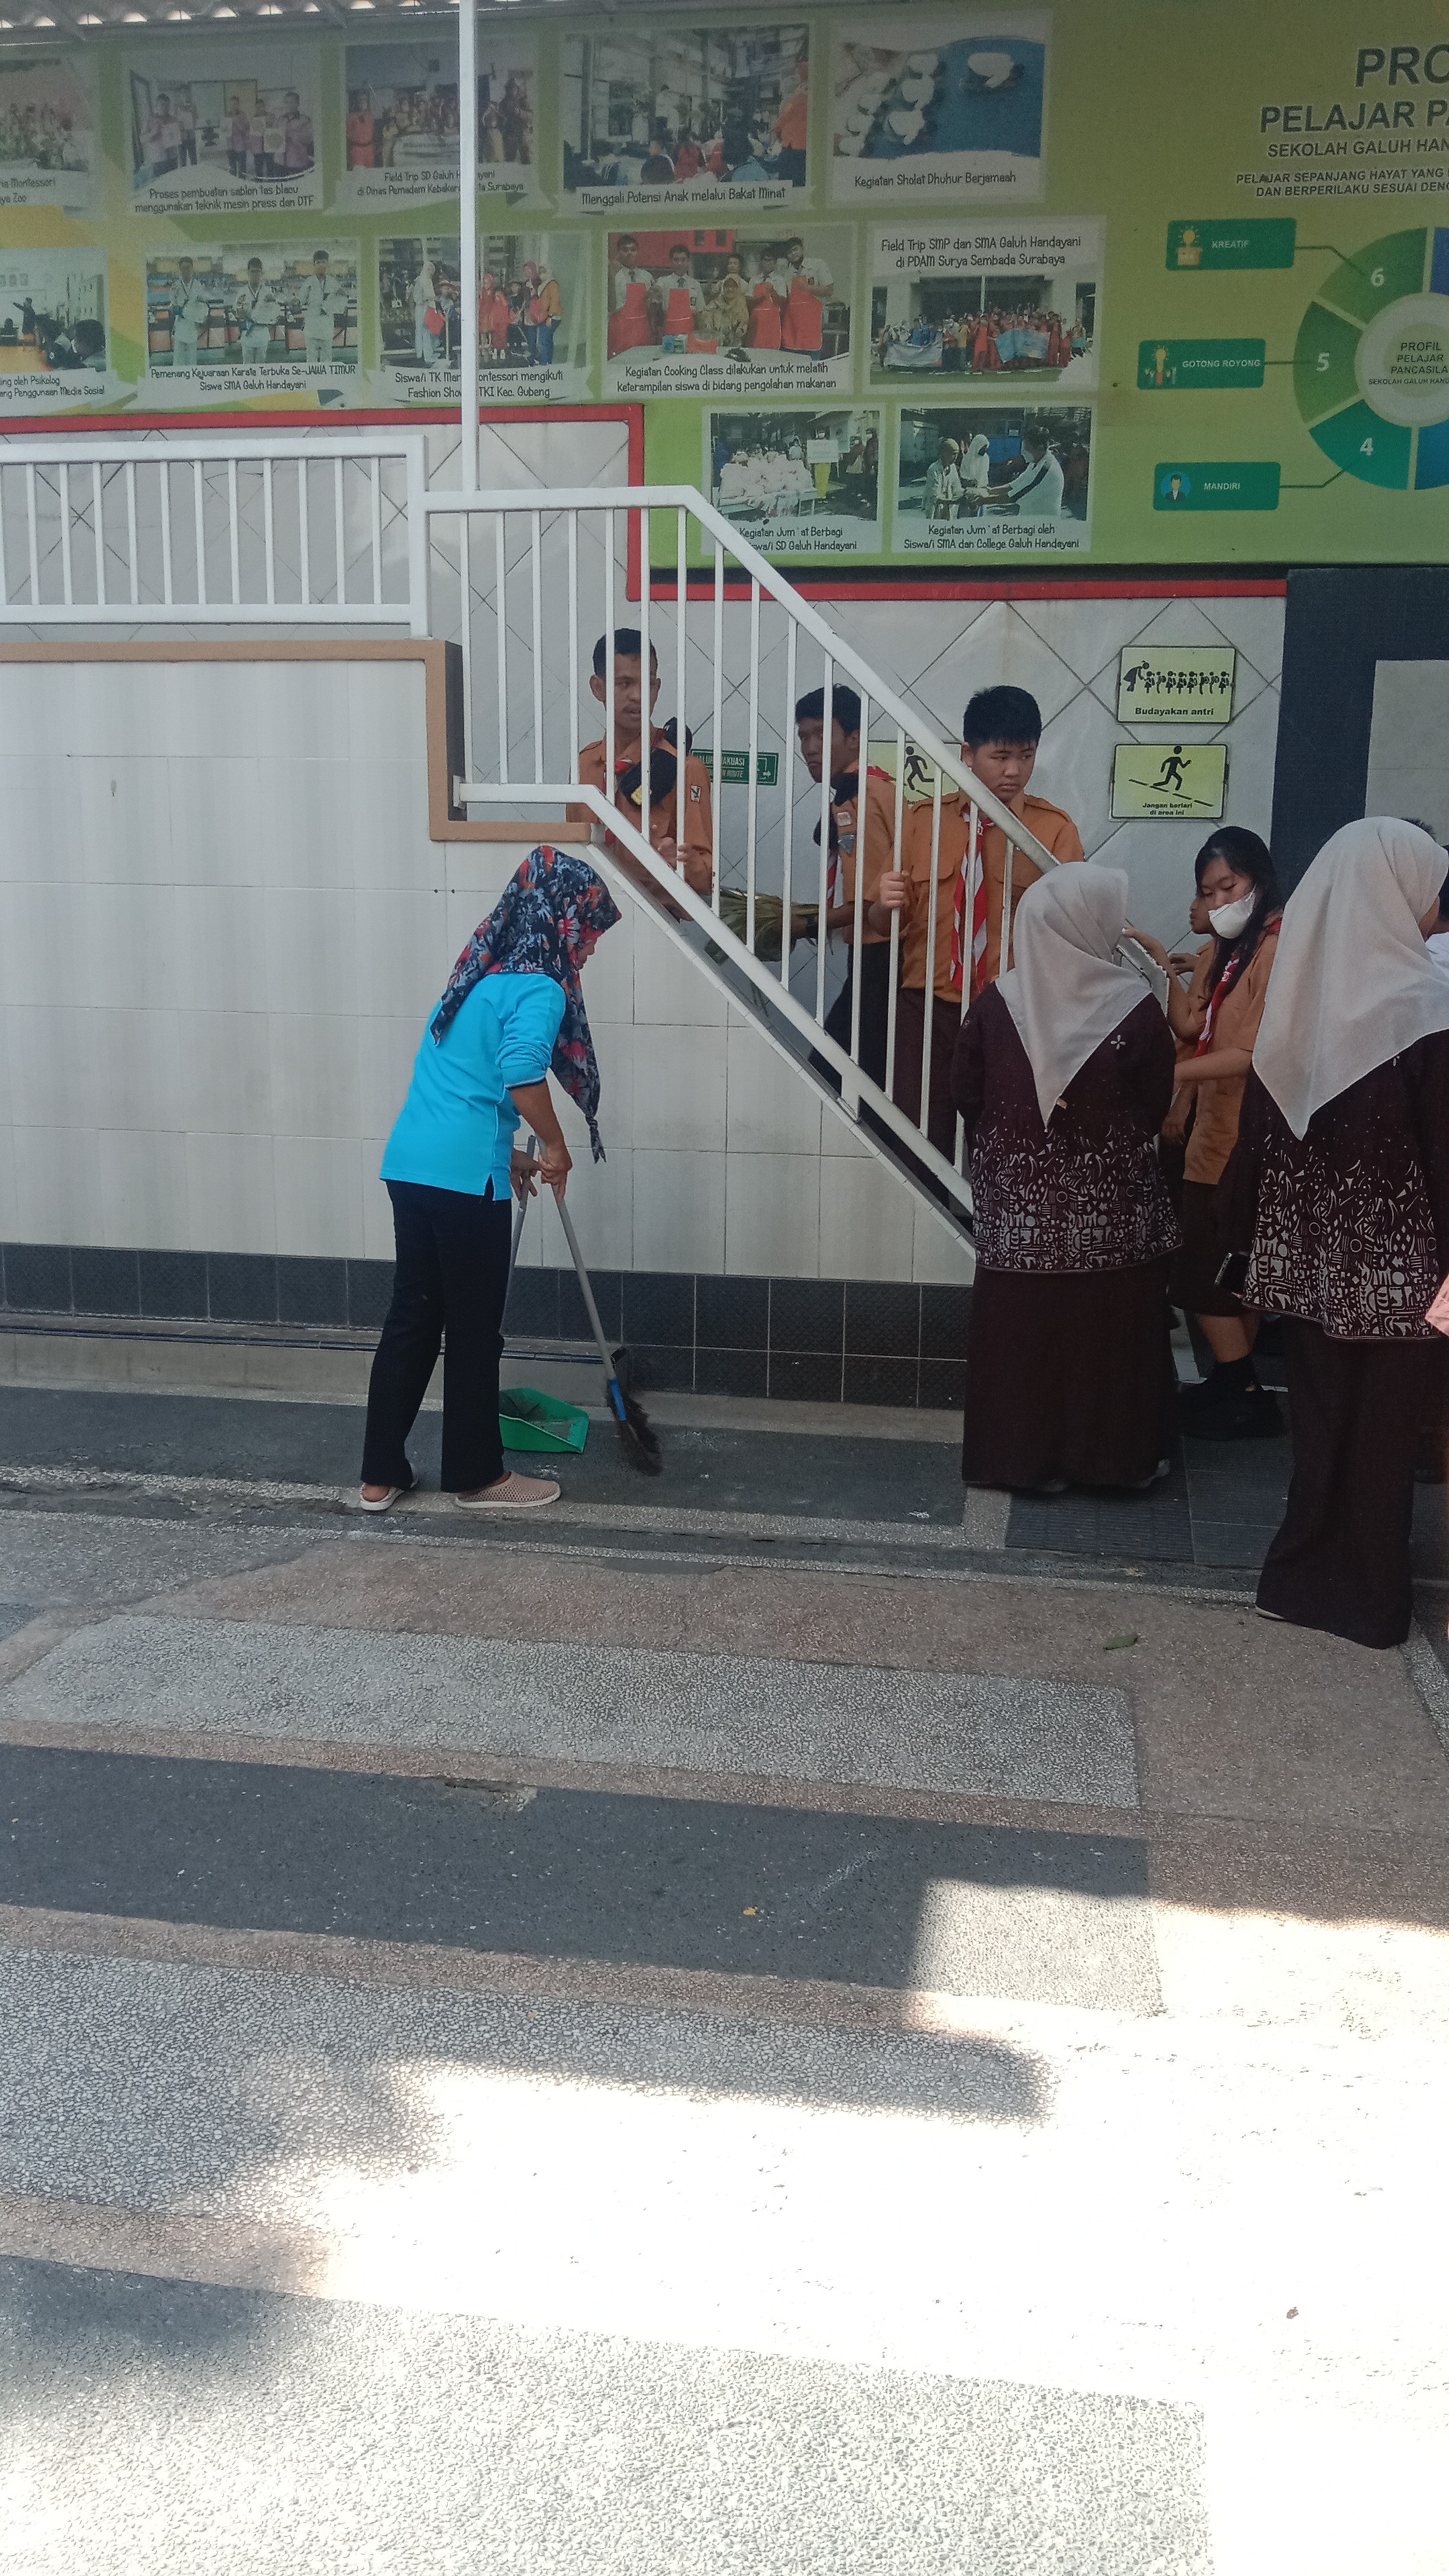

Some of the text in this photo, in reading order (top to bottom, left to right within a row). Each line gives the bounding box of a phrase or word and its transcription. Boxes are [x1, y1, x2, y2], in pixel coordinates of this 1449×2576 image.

[1260, 101, 1415, 133] PELAJAR
[1267, 142, 1348, 158] SEKOLAH
[1353, 140, 1410, 155] GALUH
[10, 178, 55, 188] Montessori
[384, 172, 402, 182] Field
[405, 172, 419, 182] Trip
[421, 171, 431, 180] SD
[433, 170, 454, 180] Galuh
[855, 170, 1016, 189] Kegiatan Sholat Dhuhur Berjamaah
[1236, 168, 1443, 184] PELAJAR SEPANJANG HAYAT YANG
[149, 188, 178, 199] Proses
[181, 186, 227, 200] pembuatan
[230, 185, 257, 197] sablon
[260, 184, 273, 195] tas
[358, 186, 364, 196] di
[366, 186, 386, 195] Dinas
[388, 184, 426, 195] Pemadam
[488, 182, 523, 193] Surabaya
[1256, 186, 1281, 197] DAN
[1285, 184, 1370, 196] BERPERILAKU
[1373, 182, 1417, 194] SESUAI
[582, 186, 786, 207] Menggali Potensi Anak melalui Bakat Minat
[135, 195, 315, 214] menggunakan teknik mesin press dan DTF
[881, 235, 1081, 253] Field Trip SMP dan SMA Galuh Handayani
[1212, 240, 1249, 248] KREATIF
[896, 254, 1065, 268] di PDAM Surya Sembada Surabaya
[1370, 268, 1385, 286] 6
[1400, 341, 1442, 351] PROFIL
[1222, 360, 1260, 368] ROYONG
[1316, 352, 1330, 372] 5
[1397, 354, 1444, 362] PELAJAR
[151, 369, 190, 380] Pemenang
[192, 368, 229, 380] Kejuaraan
[231, 368, 256, 377] Karate
[259, 366, 290, 376] Terbuka
[329, 365, 356, 375] TIMUR
[395, 372, 426, 383] Siswa/i
[429, 372, 441, 382] TK
[521, 369, 564, 383] mengikuti
[625, 362, 828, 379] Kegiatan Cooking Class dilakukan untuk melatih
[1391, 366, 1448, 374] PANCASILA
[13, 375, 28, 385] oleh
[30, 375, 60, 386] Psikolog
[200, 380, 307, 391] Siswa SMA Galuh Handayani
[617, 377, 837, 394] keterampilan siswa di bidang pengolahan makanan
[14, 388, 58, 398] Penggunaan
[60, 386, 82, 396] Media
[83, 385, 105, 395] Sosial
[408, 387, 441, 398] Fashion
[497, 386, 514, 397] Kec.
[517, 386, 550, 398] Gubeng
[1360, 437, 1374, 456] 4
[1203, 482, 1240, 490] MANDIRI
[739, 527, 774, 539] Kegiatan
[810, 527, 843, 538] Berbagi
[928, 525, 964, 537] Kegiatan
[1002, 524, 1035, 535] Berbagi
[1038, 524, 1055, 534] oleh
[775, 541, 787, 550] SD
[788, 541, 812, 550] Galuh
[814, 540, 857, 551] Handayani
[904, 538, 1079, 550] Siswa/i SMA dan College Galuh Handayani
[1135, 708, 1188, 716] Budayakan
